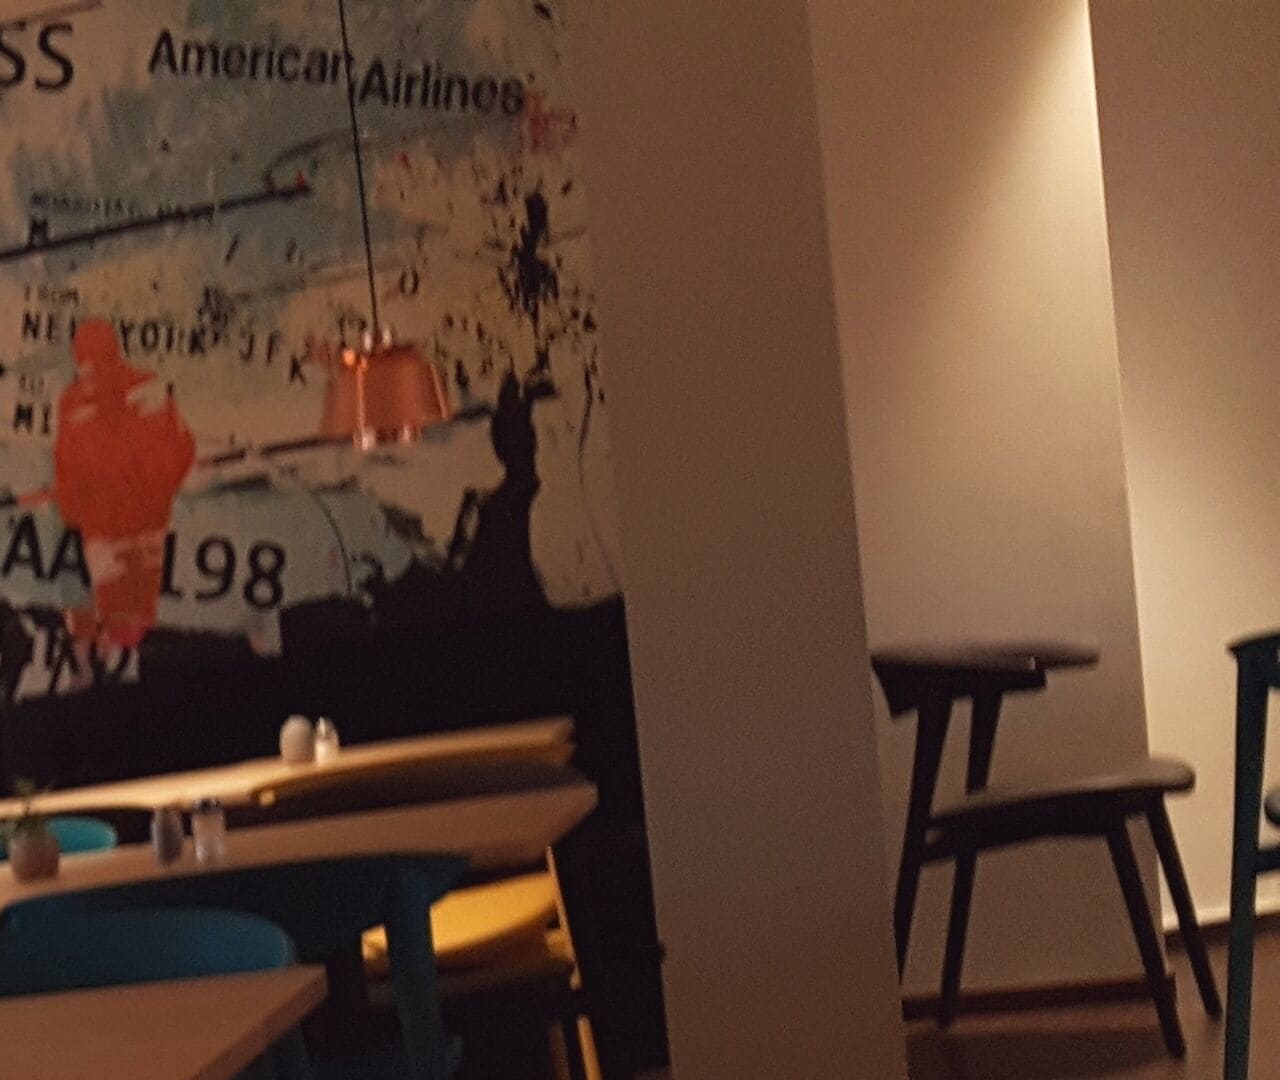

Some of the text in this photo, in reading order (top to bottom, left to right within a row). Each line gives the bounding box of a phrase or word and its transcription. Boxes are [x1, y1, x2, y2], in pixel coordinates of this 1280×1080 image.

[148, 28, 524, 116] American Airlines
[23, 311, 76, 341] NE
[0, 511, 287, 611] AA 198
